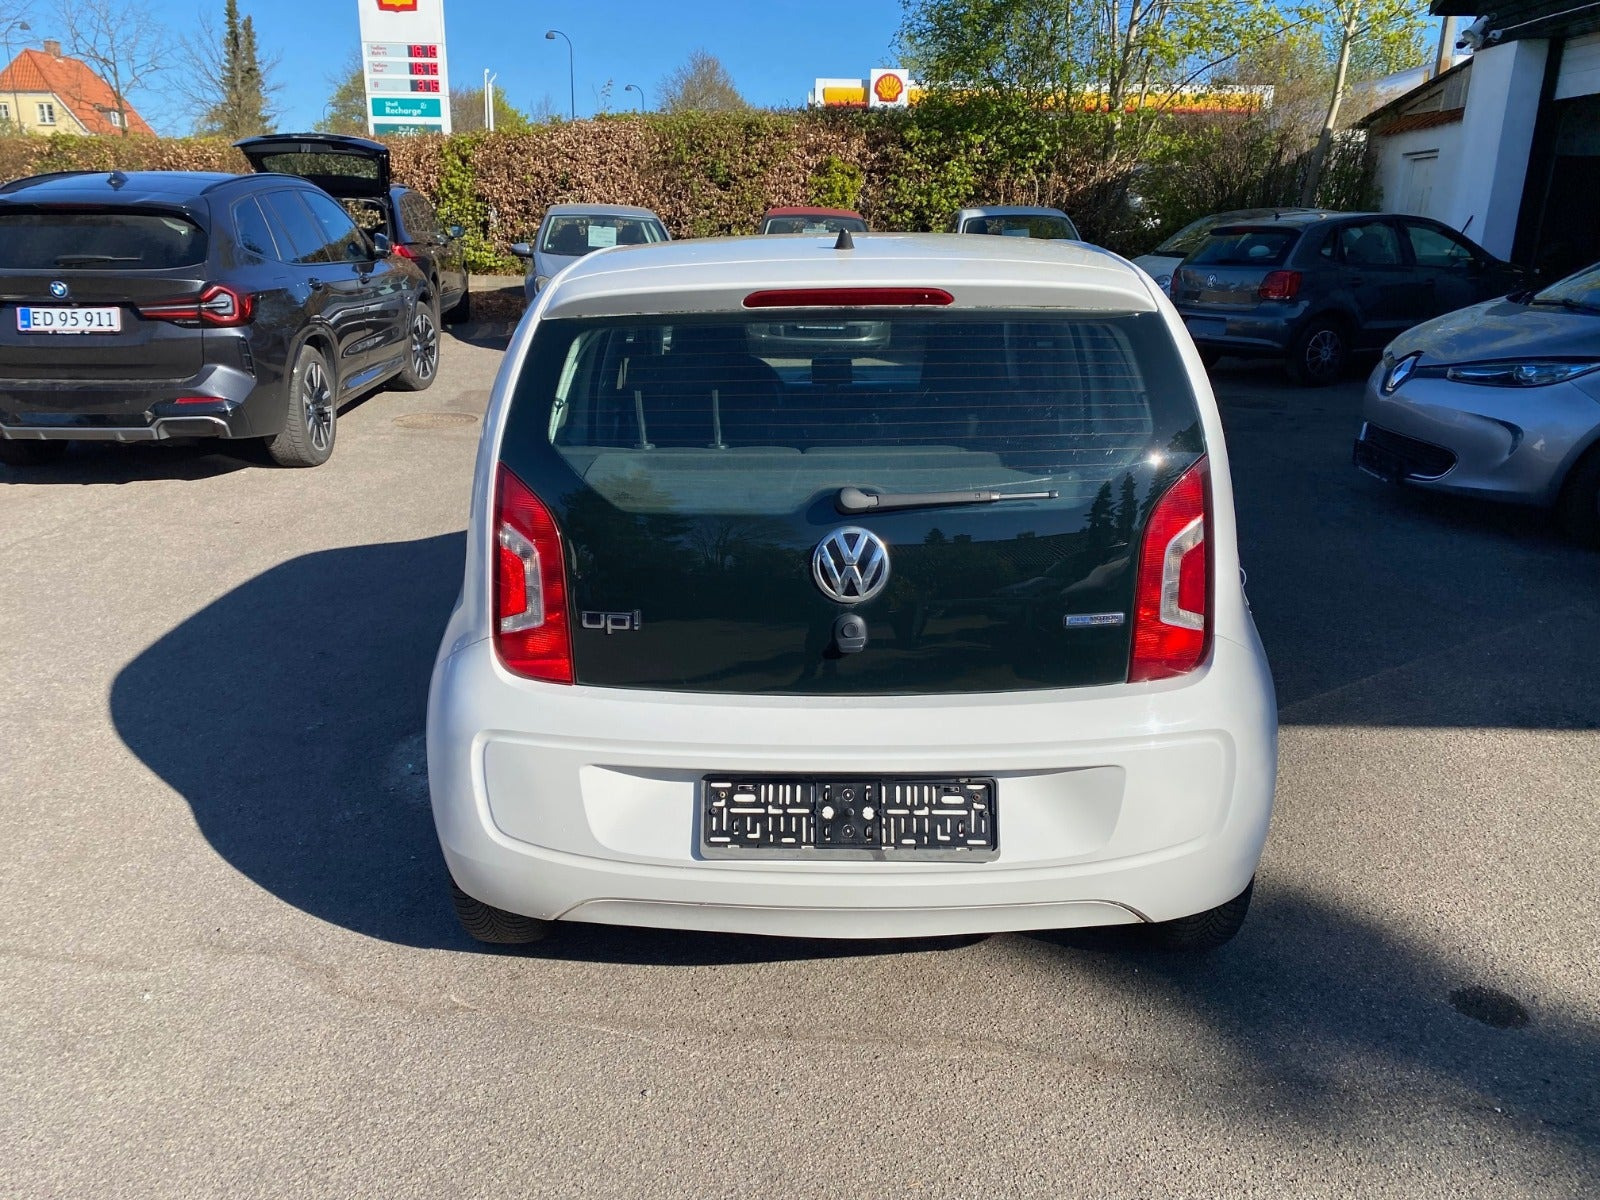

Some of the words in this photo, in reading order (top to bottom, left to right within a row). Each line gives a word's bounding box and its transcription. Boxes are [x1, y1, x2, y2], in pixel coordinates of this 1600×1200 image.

[385, 106, 422, 116] Recharge
[32, 311, 54, 327] ED
[59, 311, 79, 327] 95
[84, 311, 115, 327] 911
[581, 609, 641, 634] up!
